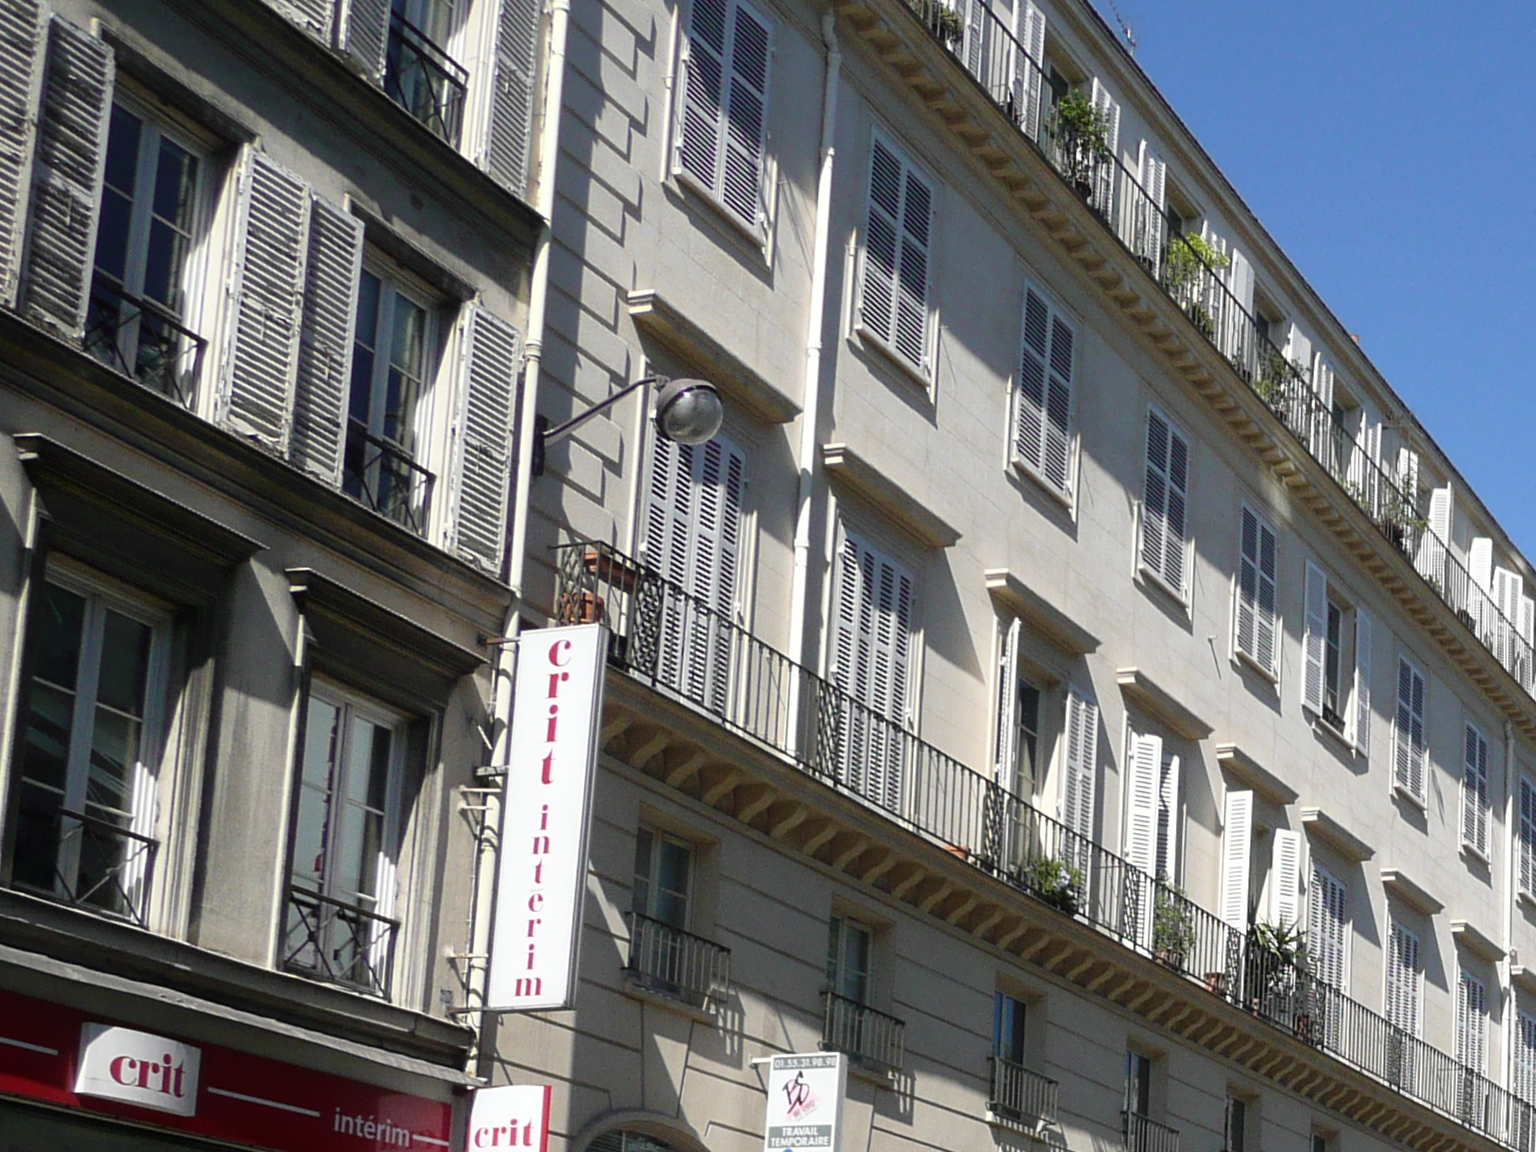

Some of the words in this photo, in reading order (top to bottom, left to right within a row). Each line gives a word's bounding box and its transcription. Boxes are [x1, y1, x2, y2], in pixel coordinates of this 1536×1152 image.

[541, 639, 572, 785] crit
[109, 1053, 186, 1098] crit
[334, 1107, 410, 1147] intérim
[474, 1118, 535, 1148] crit
[770, 1136, 830, 1147] TEMPORAIRE
[781, 1126, 819, 1136] TRAVAIL
